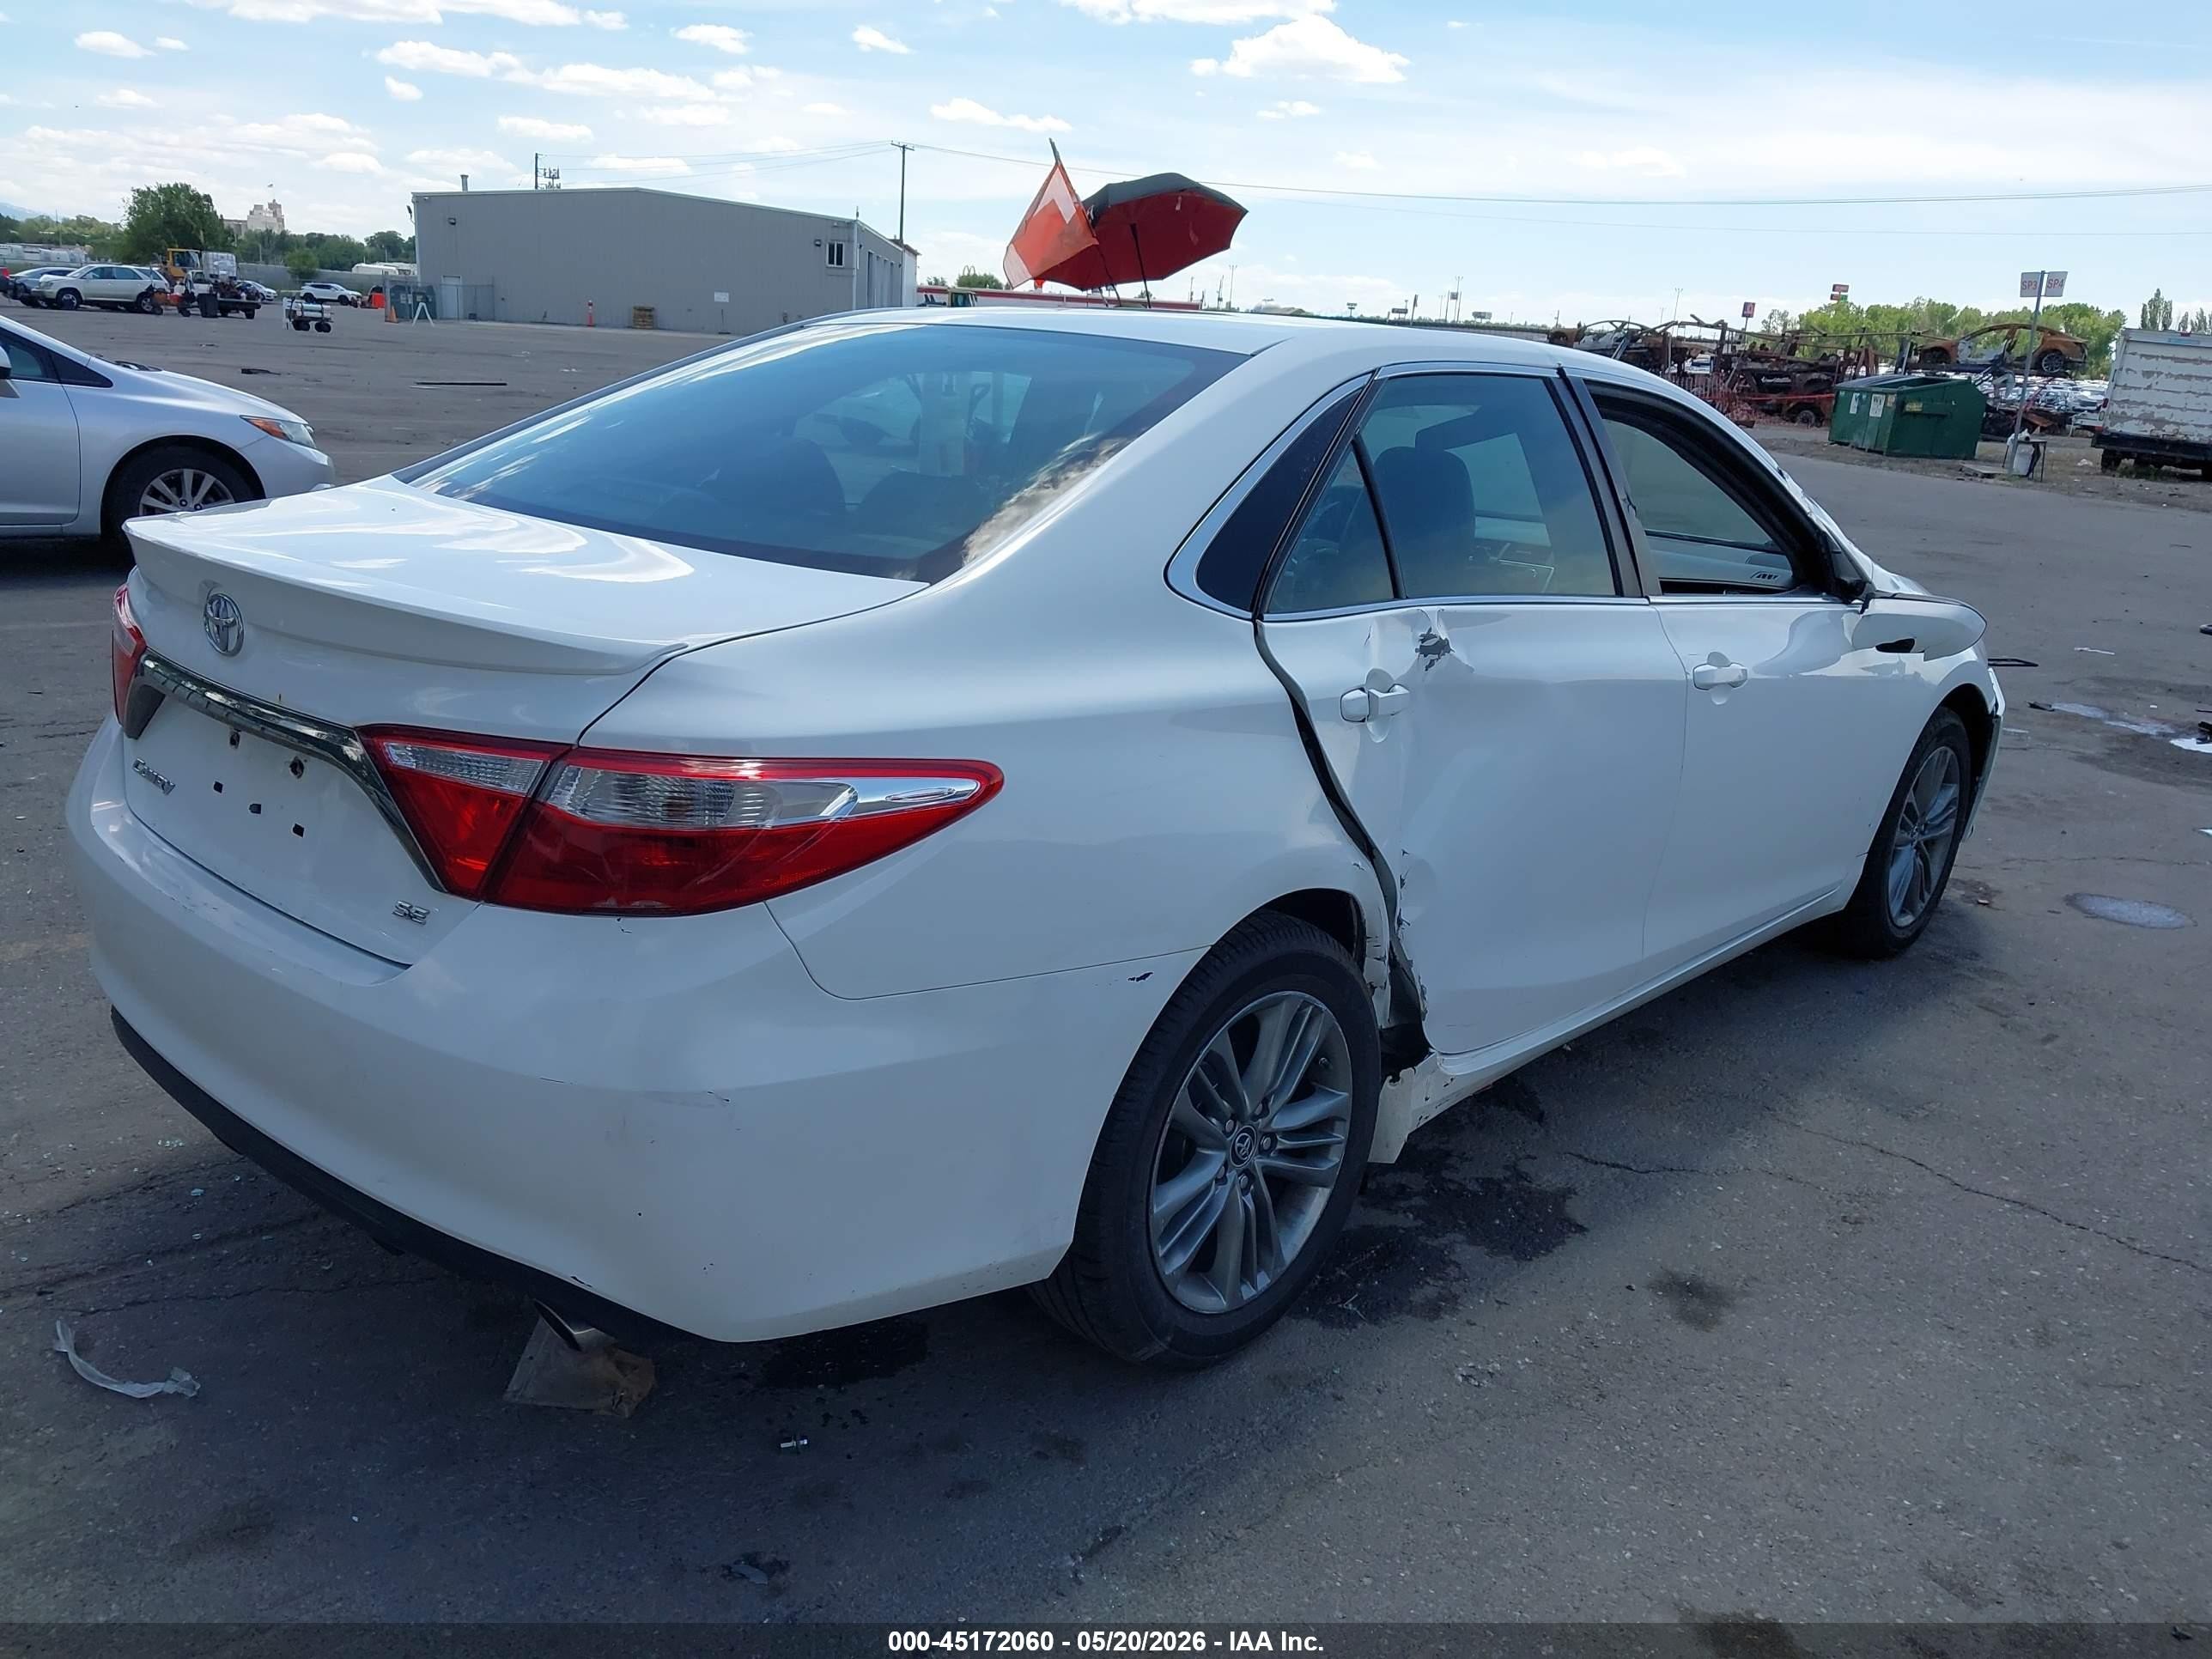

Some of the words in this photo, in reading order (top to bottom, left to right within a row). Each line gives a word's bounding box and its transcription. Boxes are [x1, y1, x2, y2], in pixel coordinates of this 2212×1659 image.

[2021, 280, 2038, 290] SP3
[2046, 278, 2064, 289] SP4
[392, 900, 430, 926] SE
